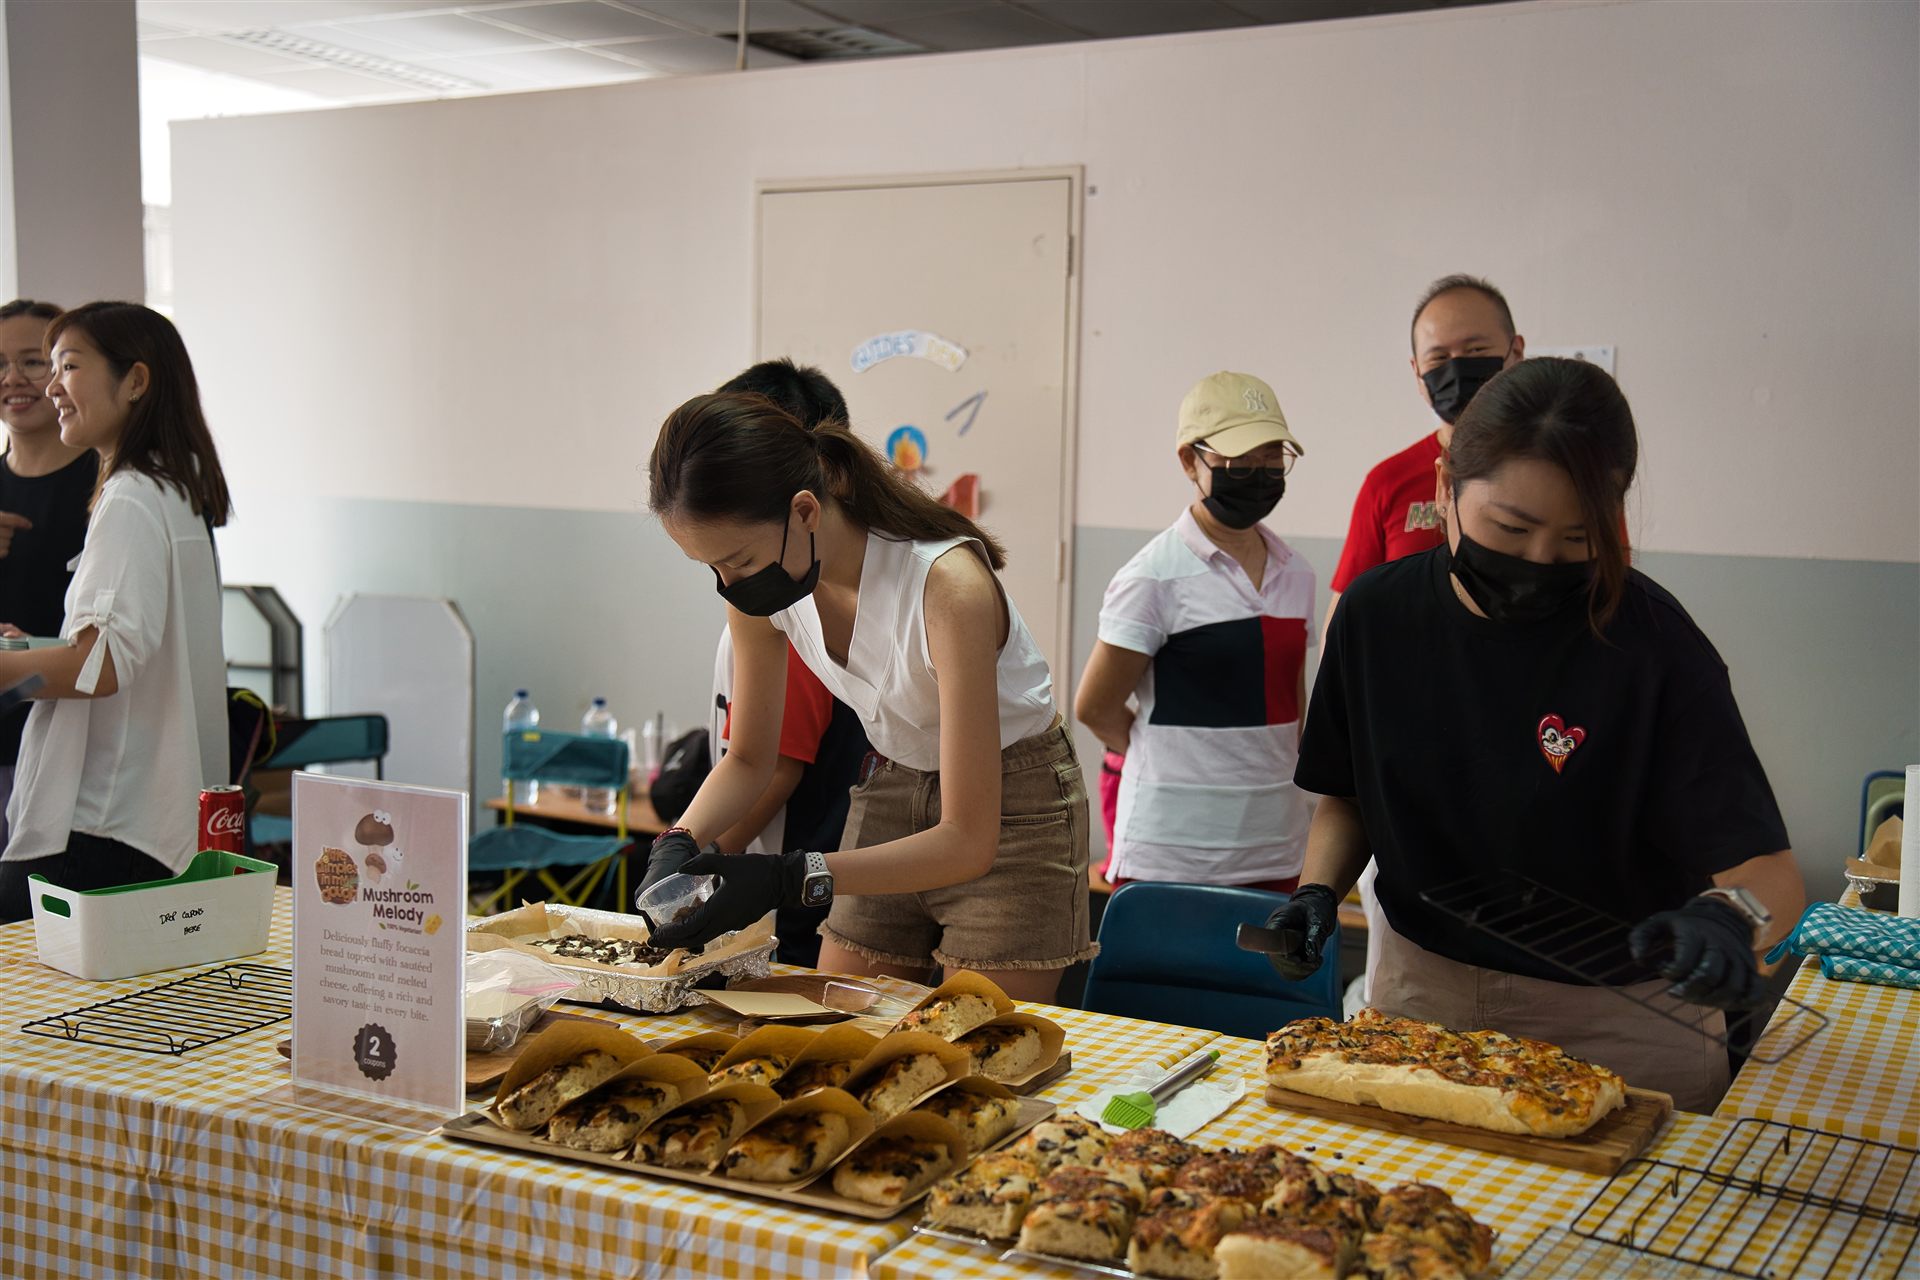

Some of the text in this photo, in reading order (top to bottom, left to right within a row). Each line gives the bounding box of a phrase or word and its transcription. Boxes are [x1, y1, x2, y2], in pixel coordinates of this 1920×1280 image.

[207, 807, 245, 836] Coca
[362, 887, 434, 904] Mushroom
[159, 910, 177, 924] DROP
[373, 903, 424, 925] Melody
[183, 923, 201, 935] HERE
[323, 929, 429, 956] Deliciously fluffy focaccia
[320, 945, 343, 958] bread
[346, 951, 375, 964] topped
[378, 956, 397, 967] with
[325, 963, 426, 988] mushrooms and melted
[319, 977, 432, 1005] cheese, offering a rich and
[322, 995, 429, 1021] savory taste in every bite.
[369, 1036, 380, 1056] 2
[363, 1057, 386, 1068] coupons
